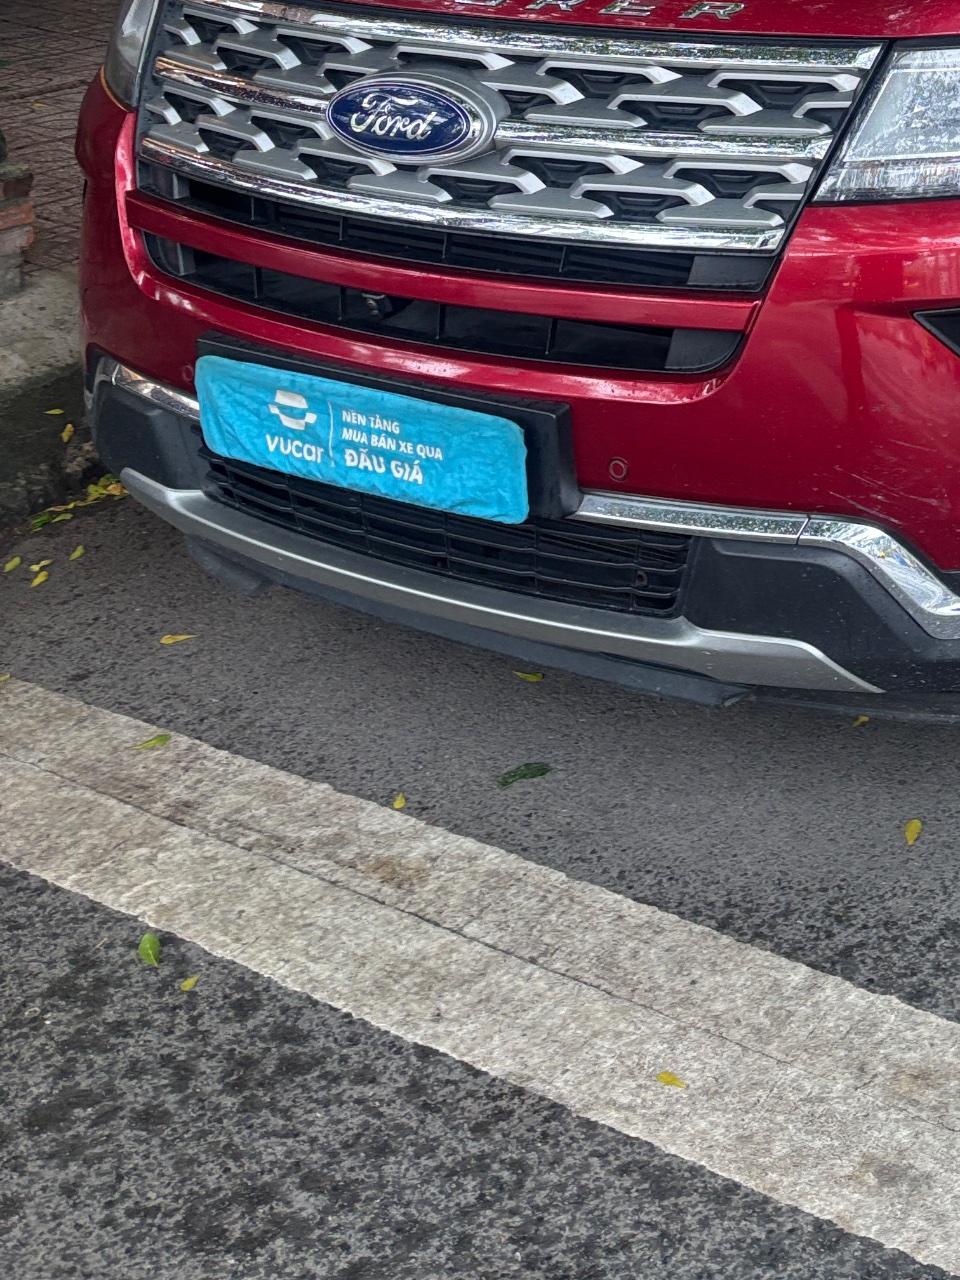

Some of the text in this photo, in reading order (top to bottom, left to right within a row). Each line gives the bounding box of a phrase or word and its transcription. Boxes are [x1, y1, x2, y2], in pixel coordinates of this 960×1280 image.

[350, 93, 438, 141] Ford
[368, 414, 401, 435] TẢNG
[265, 434, 325, 464] vucar
[341, 427, 444, 461] MUA BÁN XE QUA
[390, 460, 424, 485] GIÁ
